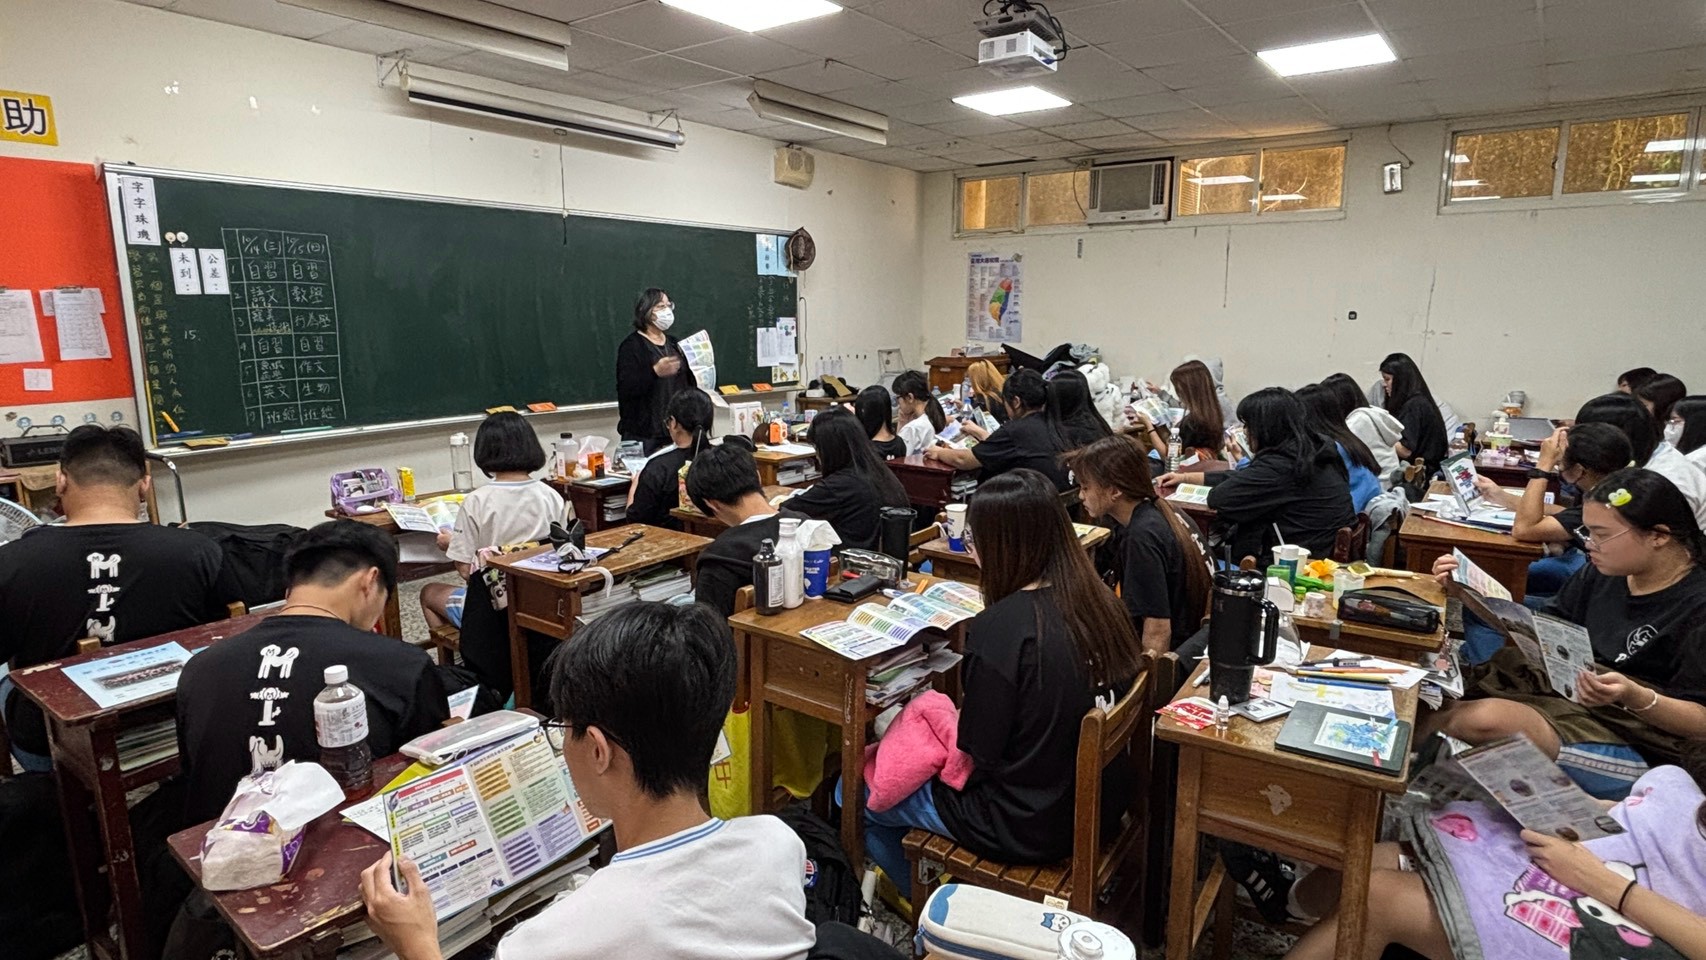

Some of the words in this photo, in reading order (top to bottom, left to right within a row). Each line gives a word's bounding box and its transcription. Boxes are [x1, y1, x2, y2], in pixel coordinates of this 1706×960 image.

[3, 98, 46, 135] 助
[132, 181, 151, 241] 字字珠璣
[248, 260, 278, 280] 自習
[292, 261, 319, 280] 自習
[291, 286, 323, 304] 數學
[258, 338, 283, 355] 自習
[300, 336, 324, 352] 自習
[300, 360, 327, 374] 作文
[263, 384, 290, 399] 英文
[303, 382, 331, 397] 生物
